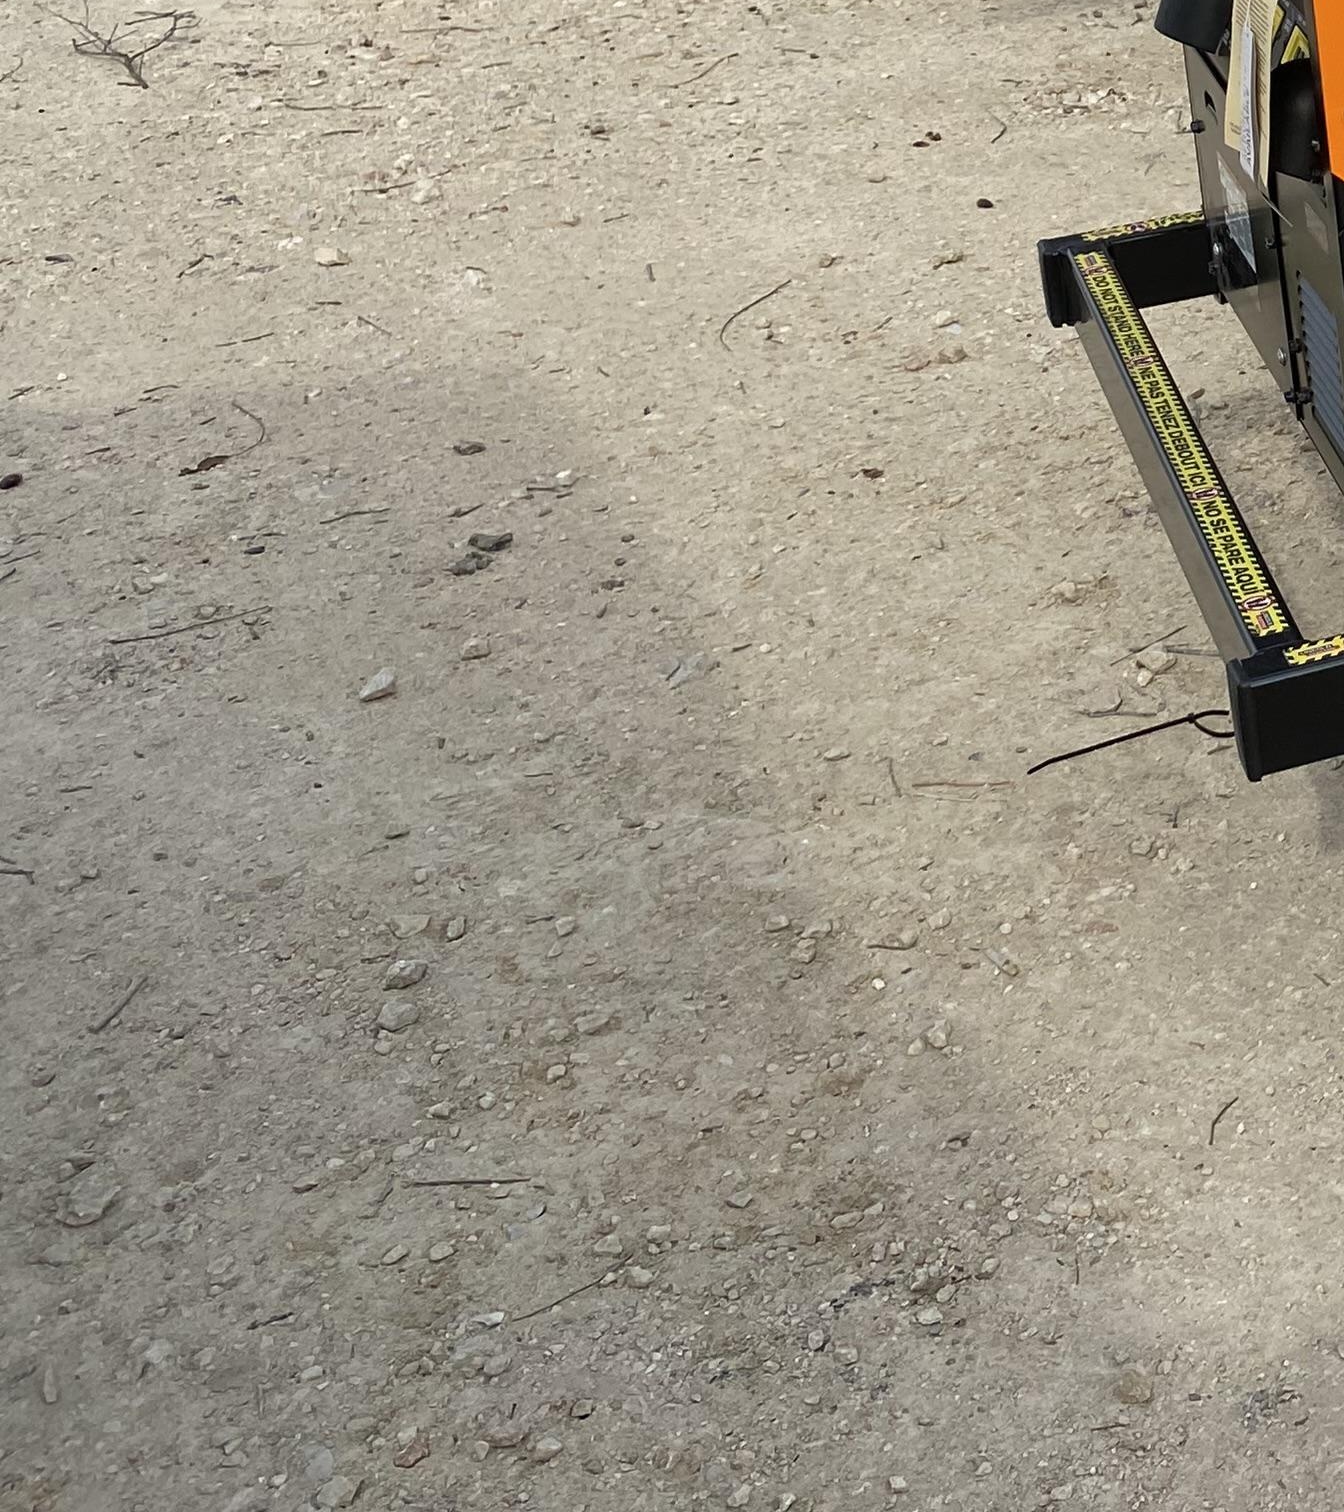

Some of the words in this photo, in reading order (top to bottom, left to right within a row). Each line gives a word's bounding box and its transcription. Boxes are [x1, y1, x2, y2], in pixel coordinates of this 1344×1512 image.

[1092, 275, 1110, 288] DO
[1099, 288, 1119, 305] NOT
[1107, 304, 1132, 333] STAND
[1121, 332, 1145, 357] HERE
[1138, 366, 1156, 381] NE
[1144, 380, 1165, 400] PAS
[1154, 398, 1181, 431] TENEZ
[1167, 429, 1201, 471] DEBOUT
[1187, 471, 1207, 488] ICI
[1200, 499, 1221, 518] NO
[1209, 518, 1230, 535] SE
[1216, 534, 1246, 566] PARE
